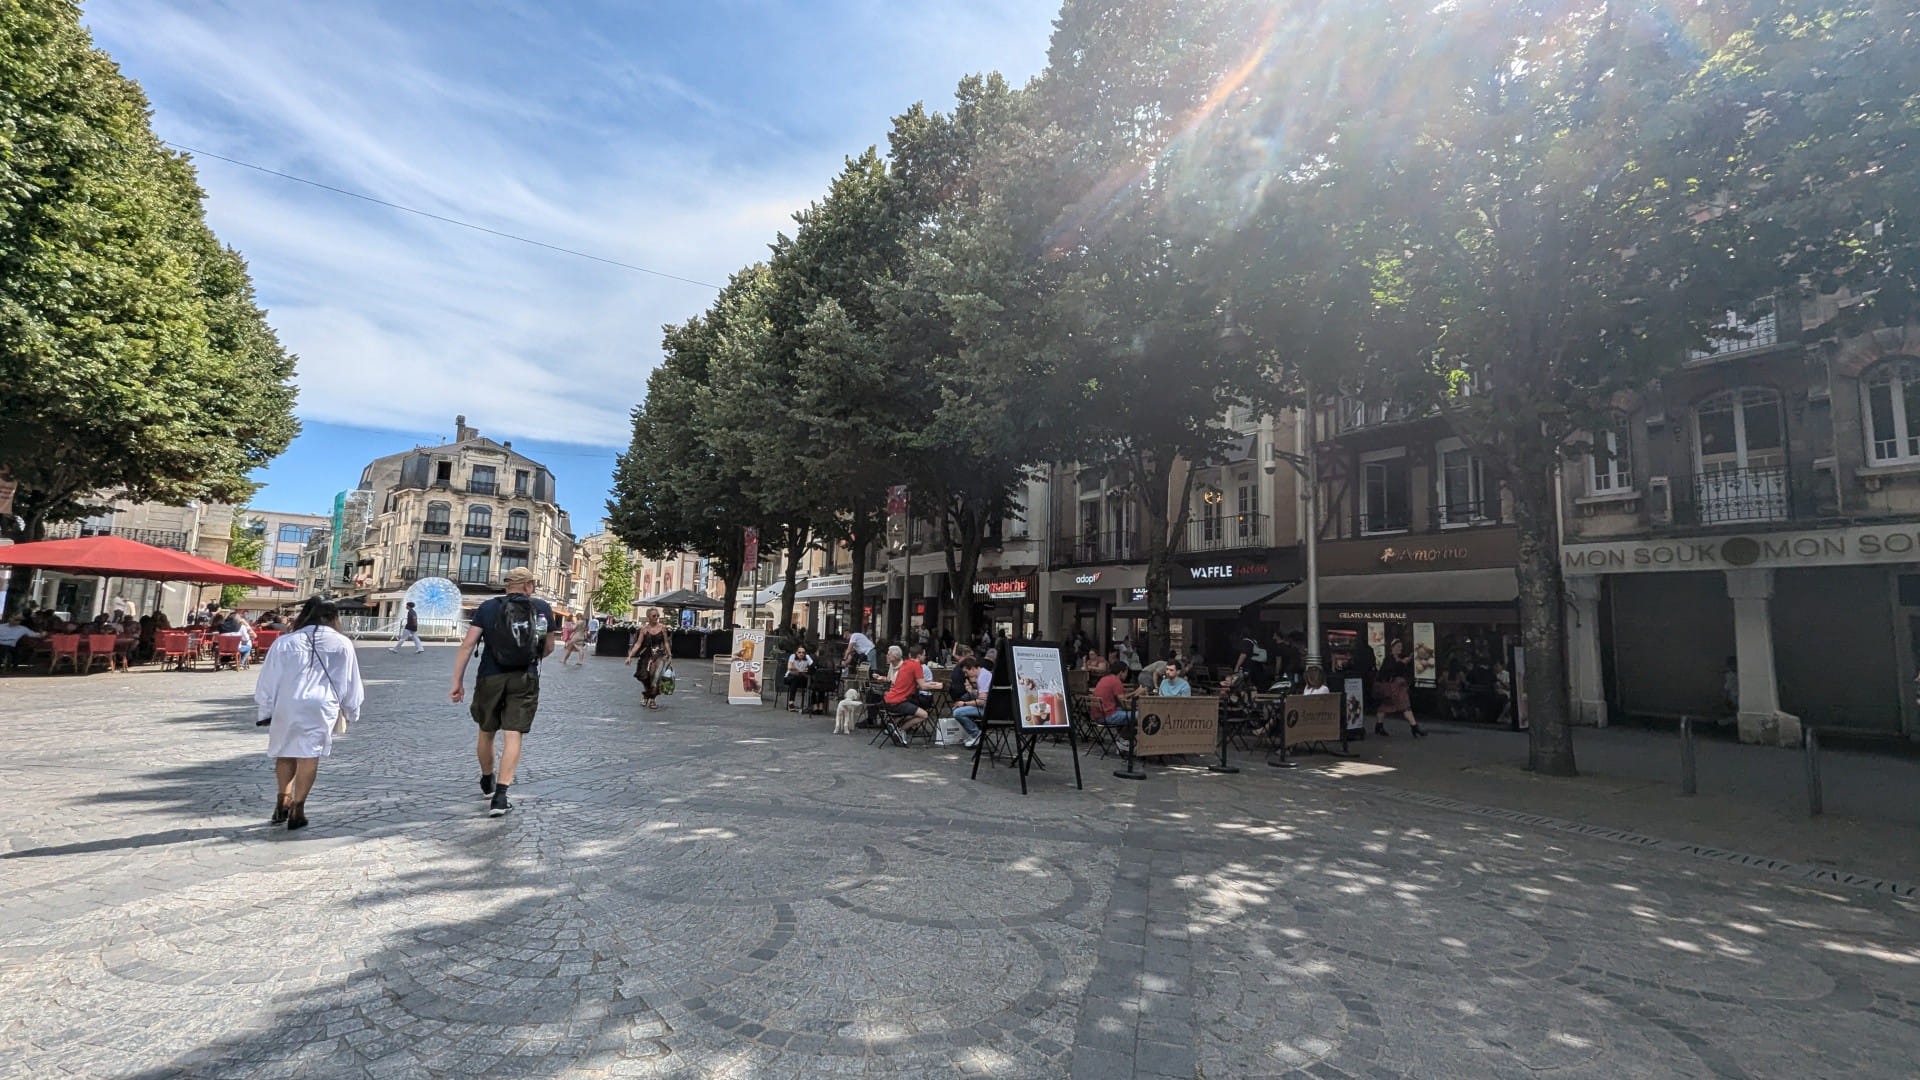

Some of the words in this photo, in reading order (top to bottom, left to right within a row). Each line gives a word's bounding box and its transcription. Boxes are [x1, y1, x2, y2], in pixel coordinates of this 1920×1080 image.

[1762, 536, 1846, 559] MON
[1858, 532, 1920, 553] SO
[1400, 546, 1468, 561] Amorino
[1565, 550, 1625, 568] MON
[1634, 544, 1715, 566] SOUK
[1190, 565, 1233, 579] WAFFLE
[735, 631, 764, 645] FRAP
[1161, 713, 1213, 729] Amorino
